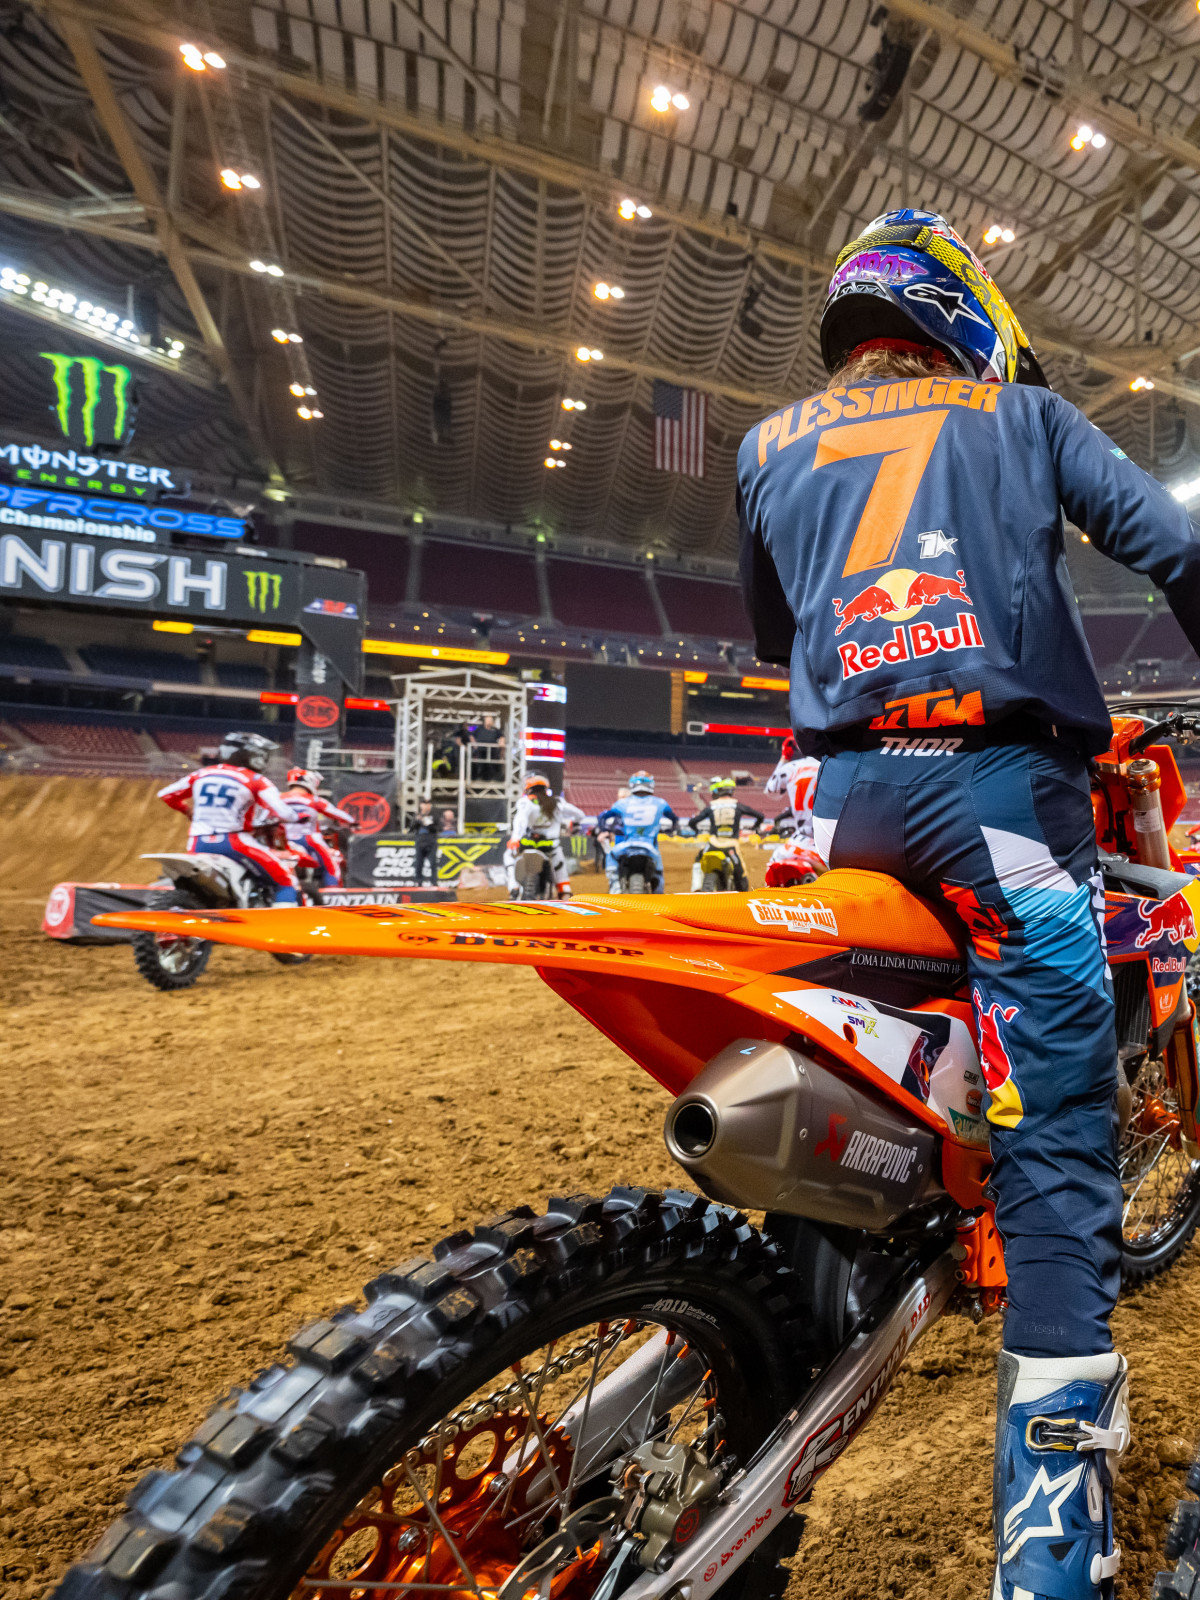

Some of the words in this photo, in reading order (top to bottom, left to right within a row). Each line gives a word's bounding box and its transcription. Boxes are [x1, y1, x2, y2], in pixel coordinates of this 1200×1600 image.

[758, 376, 1003, 468] PLESSINGER
[17, 469, 147, 496] ENERGY
[812, 409, 950, 578] 7
[0, 534, 228, 611] NISH
[837, 625, 910, 680] Red
[909, 612, 985, 660] Bull
[868, 688, 987, 731] KTM
[879, 736, 964, 757] THOR
[198, 782, 238, 808] 55
[625, 804, 658, 827] 3
[754, 904, 784, 921] SELLE
[784, 909, 812, 923] DALLA
[811, 911, 836, 930] VALLE
[449, 934, 645, 957] DUNLOP
[852, 953, 878, 967] LOMA
[879, 956, 906, 969] LINDA
[907, 958, 951, 974] UNIVERSITY
[1152, 957, 1171, 973] Red
[1171, 957, 1187, 973] Bull
[720, 1507, 773, 1567] brembo
